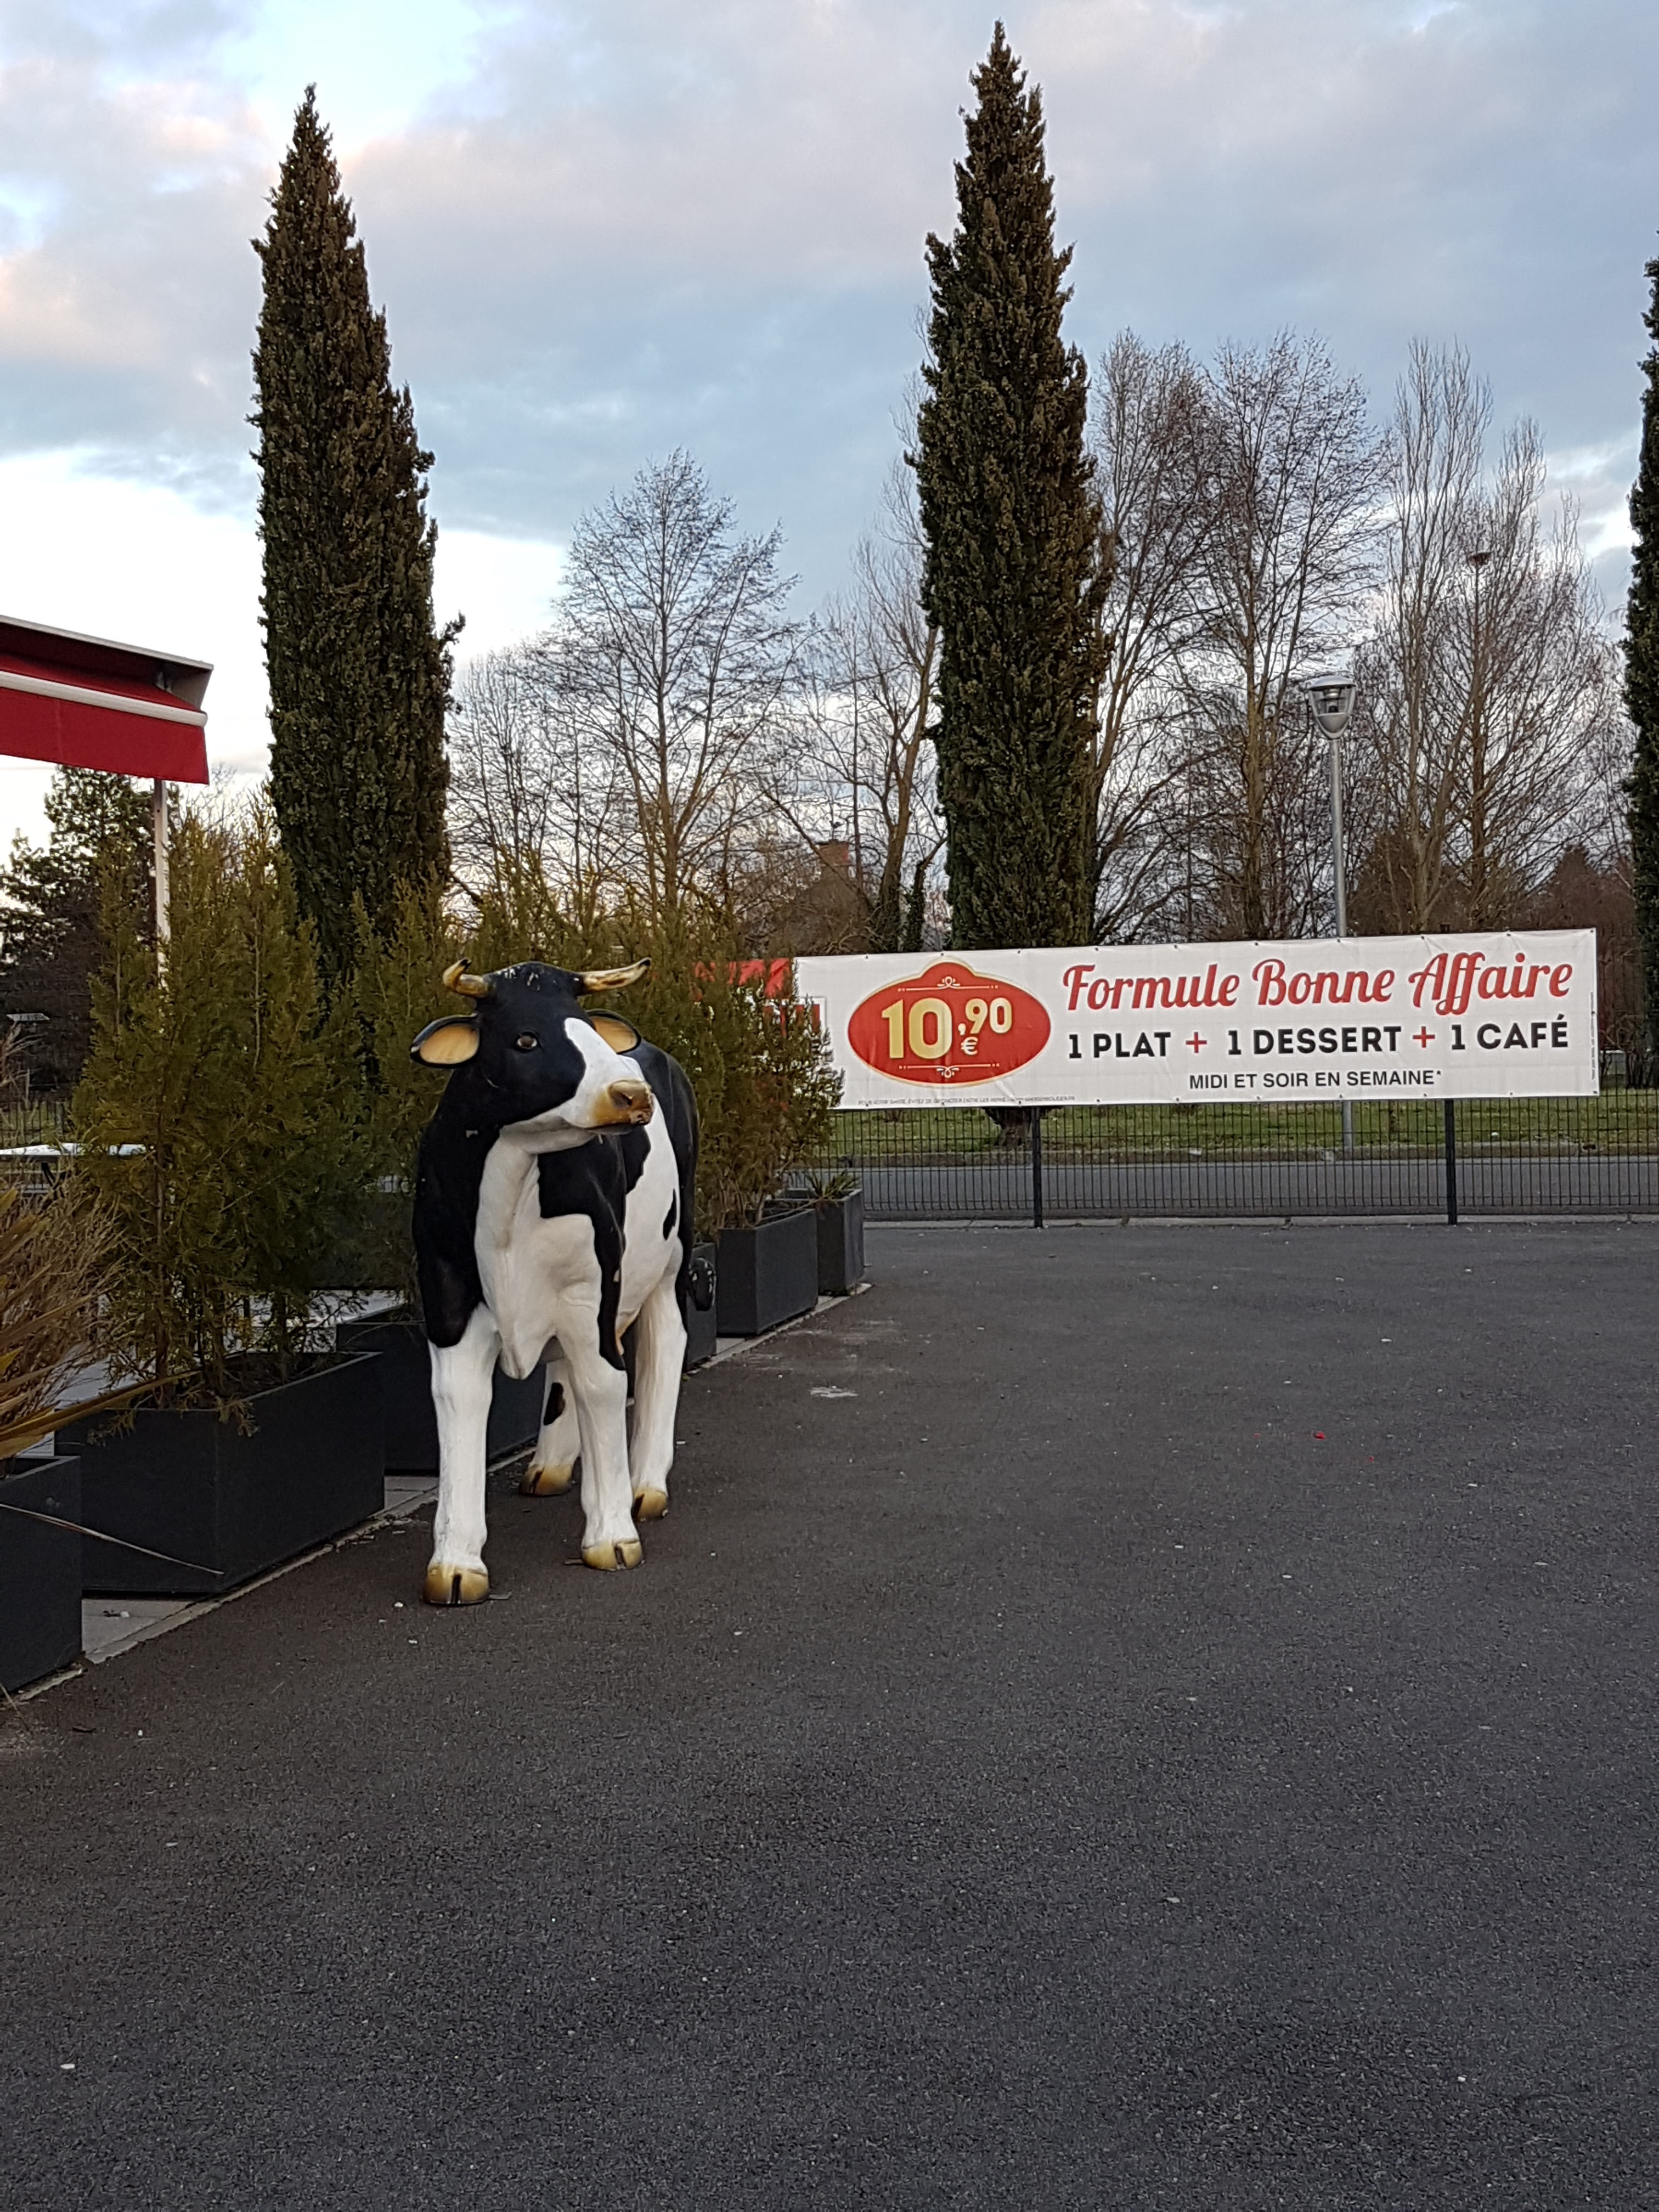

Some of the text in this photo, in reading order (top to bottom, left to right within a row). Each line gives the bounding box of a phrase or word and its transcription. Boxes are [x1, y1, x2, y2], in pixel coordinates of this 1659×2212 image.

[1063, 952, 1572, 1015] Formule Bonne Affaire
[1069, 1034, 1082, 1059] 1
[1093, 1031, 1171, 1058] PLAT
[1228, 1030, 1242, 1055] 1
[1253, 1026, 1402, 1054] DESSERT
[1451, 1024, 1465, 1050] 1
[1477, 1013, 1568, 1049] CAFÉ
[1189, 1074, 1227, 1089] MIDI
[1234, 1073, 1257, 1088] ET
[1263, 1073, 1308, 1088] SOIR
[1316, 1071, 1340, 1087] EN
